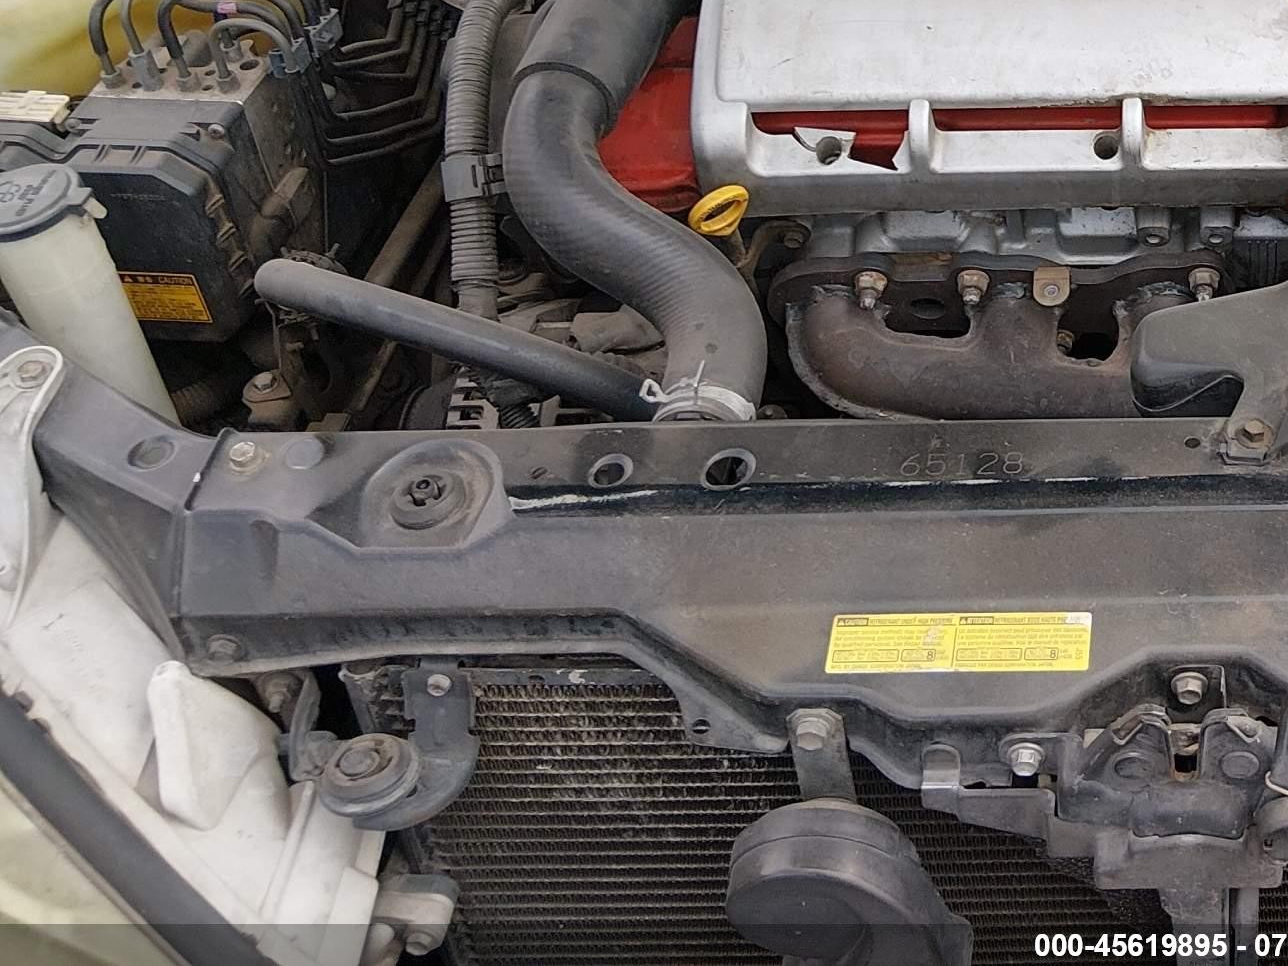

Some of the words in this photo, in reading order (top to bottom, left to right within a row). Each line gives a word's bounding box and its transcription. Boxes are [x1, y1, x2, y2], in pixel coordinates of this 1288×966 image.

[900, 451, 1024, 476] 65128
[927, 650, 935, 660] 8
[1049, 649, 1057, 659] 8
